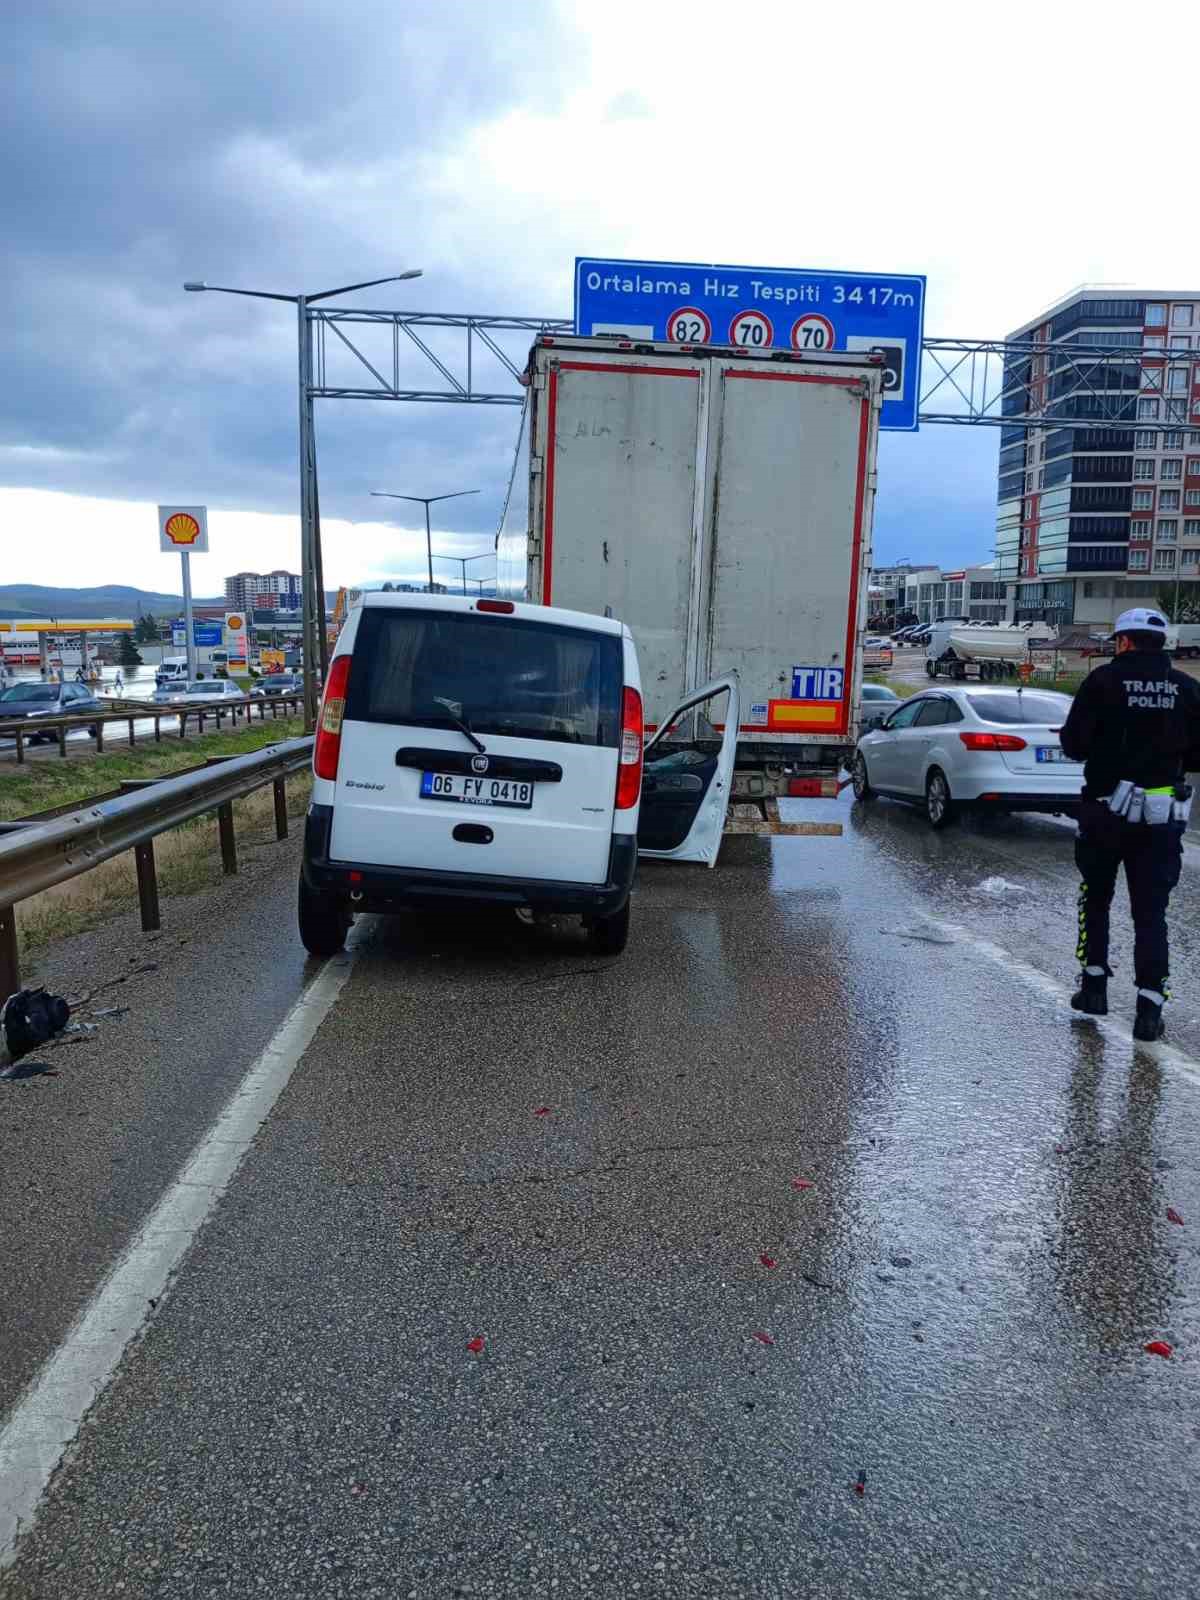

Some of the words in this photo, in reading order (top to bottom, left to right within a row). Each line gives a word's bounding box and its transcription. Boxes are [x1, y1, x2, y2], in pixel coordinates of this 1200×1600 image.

[587, 272, 691, 295] Ortalama
[704, 278, 738, 298] Hız
[751, 281, 820, 305] Tespiti
[676, 321, 701, 342] 82
[740, 324, 763, 345] 70
[802, 328, 825, 348] 70
[795, 669, 842, 698] TIR
[1122, 679, 1179, 696] TRAFİK
[1127, 694, 1175, 710] POLİSİ
[433, 775, 453, 793] 06
[463, 779, 484, 796] FV
[491, 782, 529, 801] 0418
